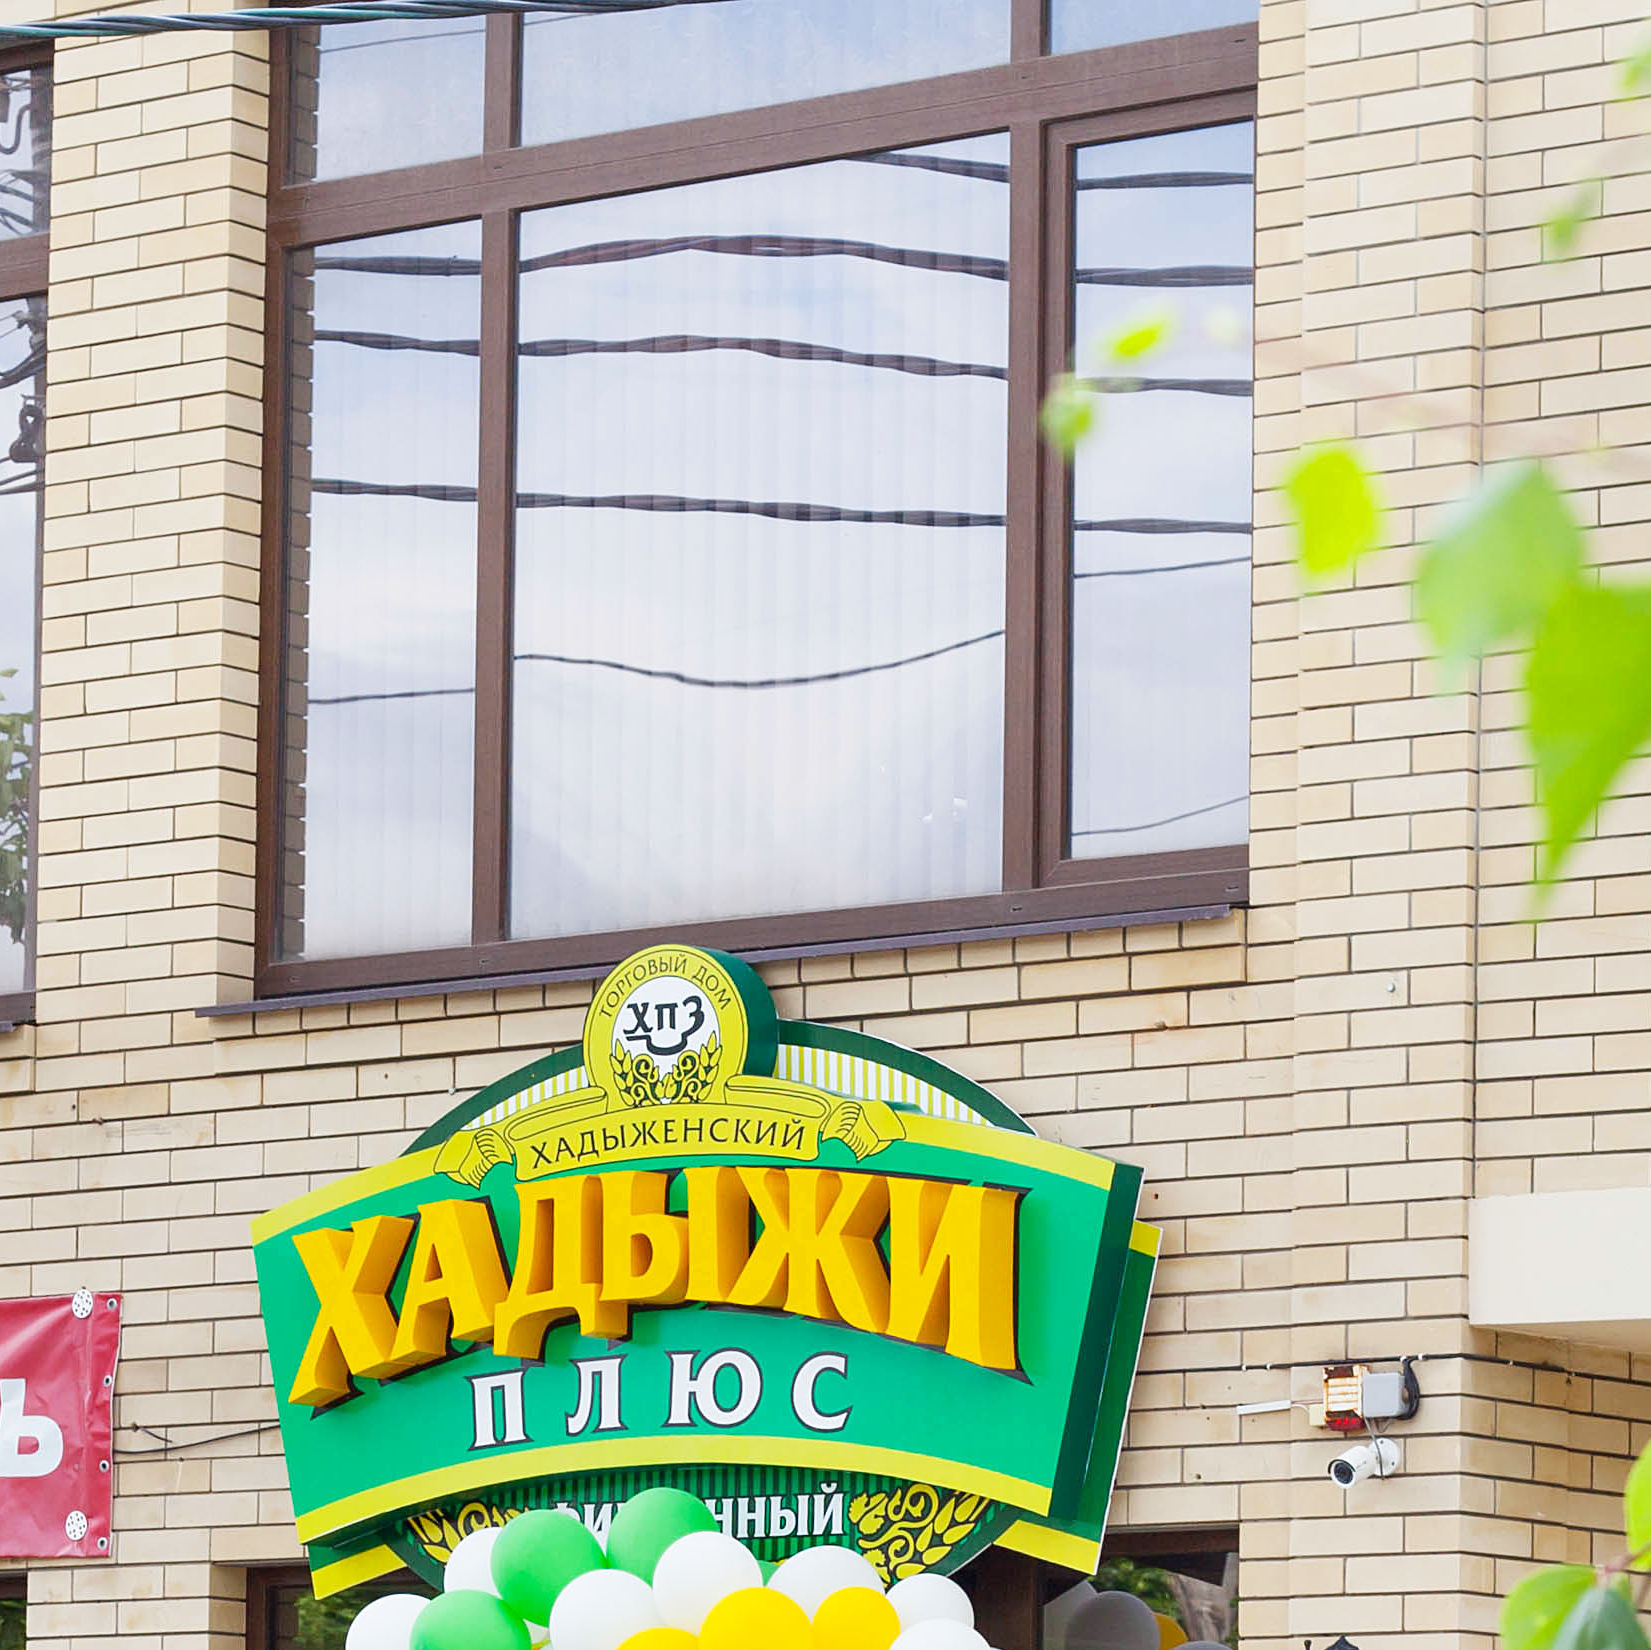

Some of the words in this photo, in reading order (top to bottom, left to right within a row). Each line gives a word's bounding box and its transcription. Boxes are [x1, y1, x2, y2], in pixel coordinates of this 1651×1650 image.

[599, 953, 688, 1017] ТОРГОВЫЙ
[691, 964, 732, 1011] ДОМ
[623, 995, 706, 1045] ХПЗ
[531, 1118, 806, 1170] ХАДЫЖЕНСКИЙ
[288, 1166, 1022, 1408] ХАДЫЖИ
[466, 1347, 854, 1451] ПЛЮС
